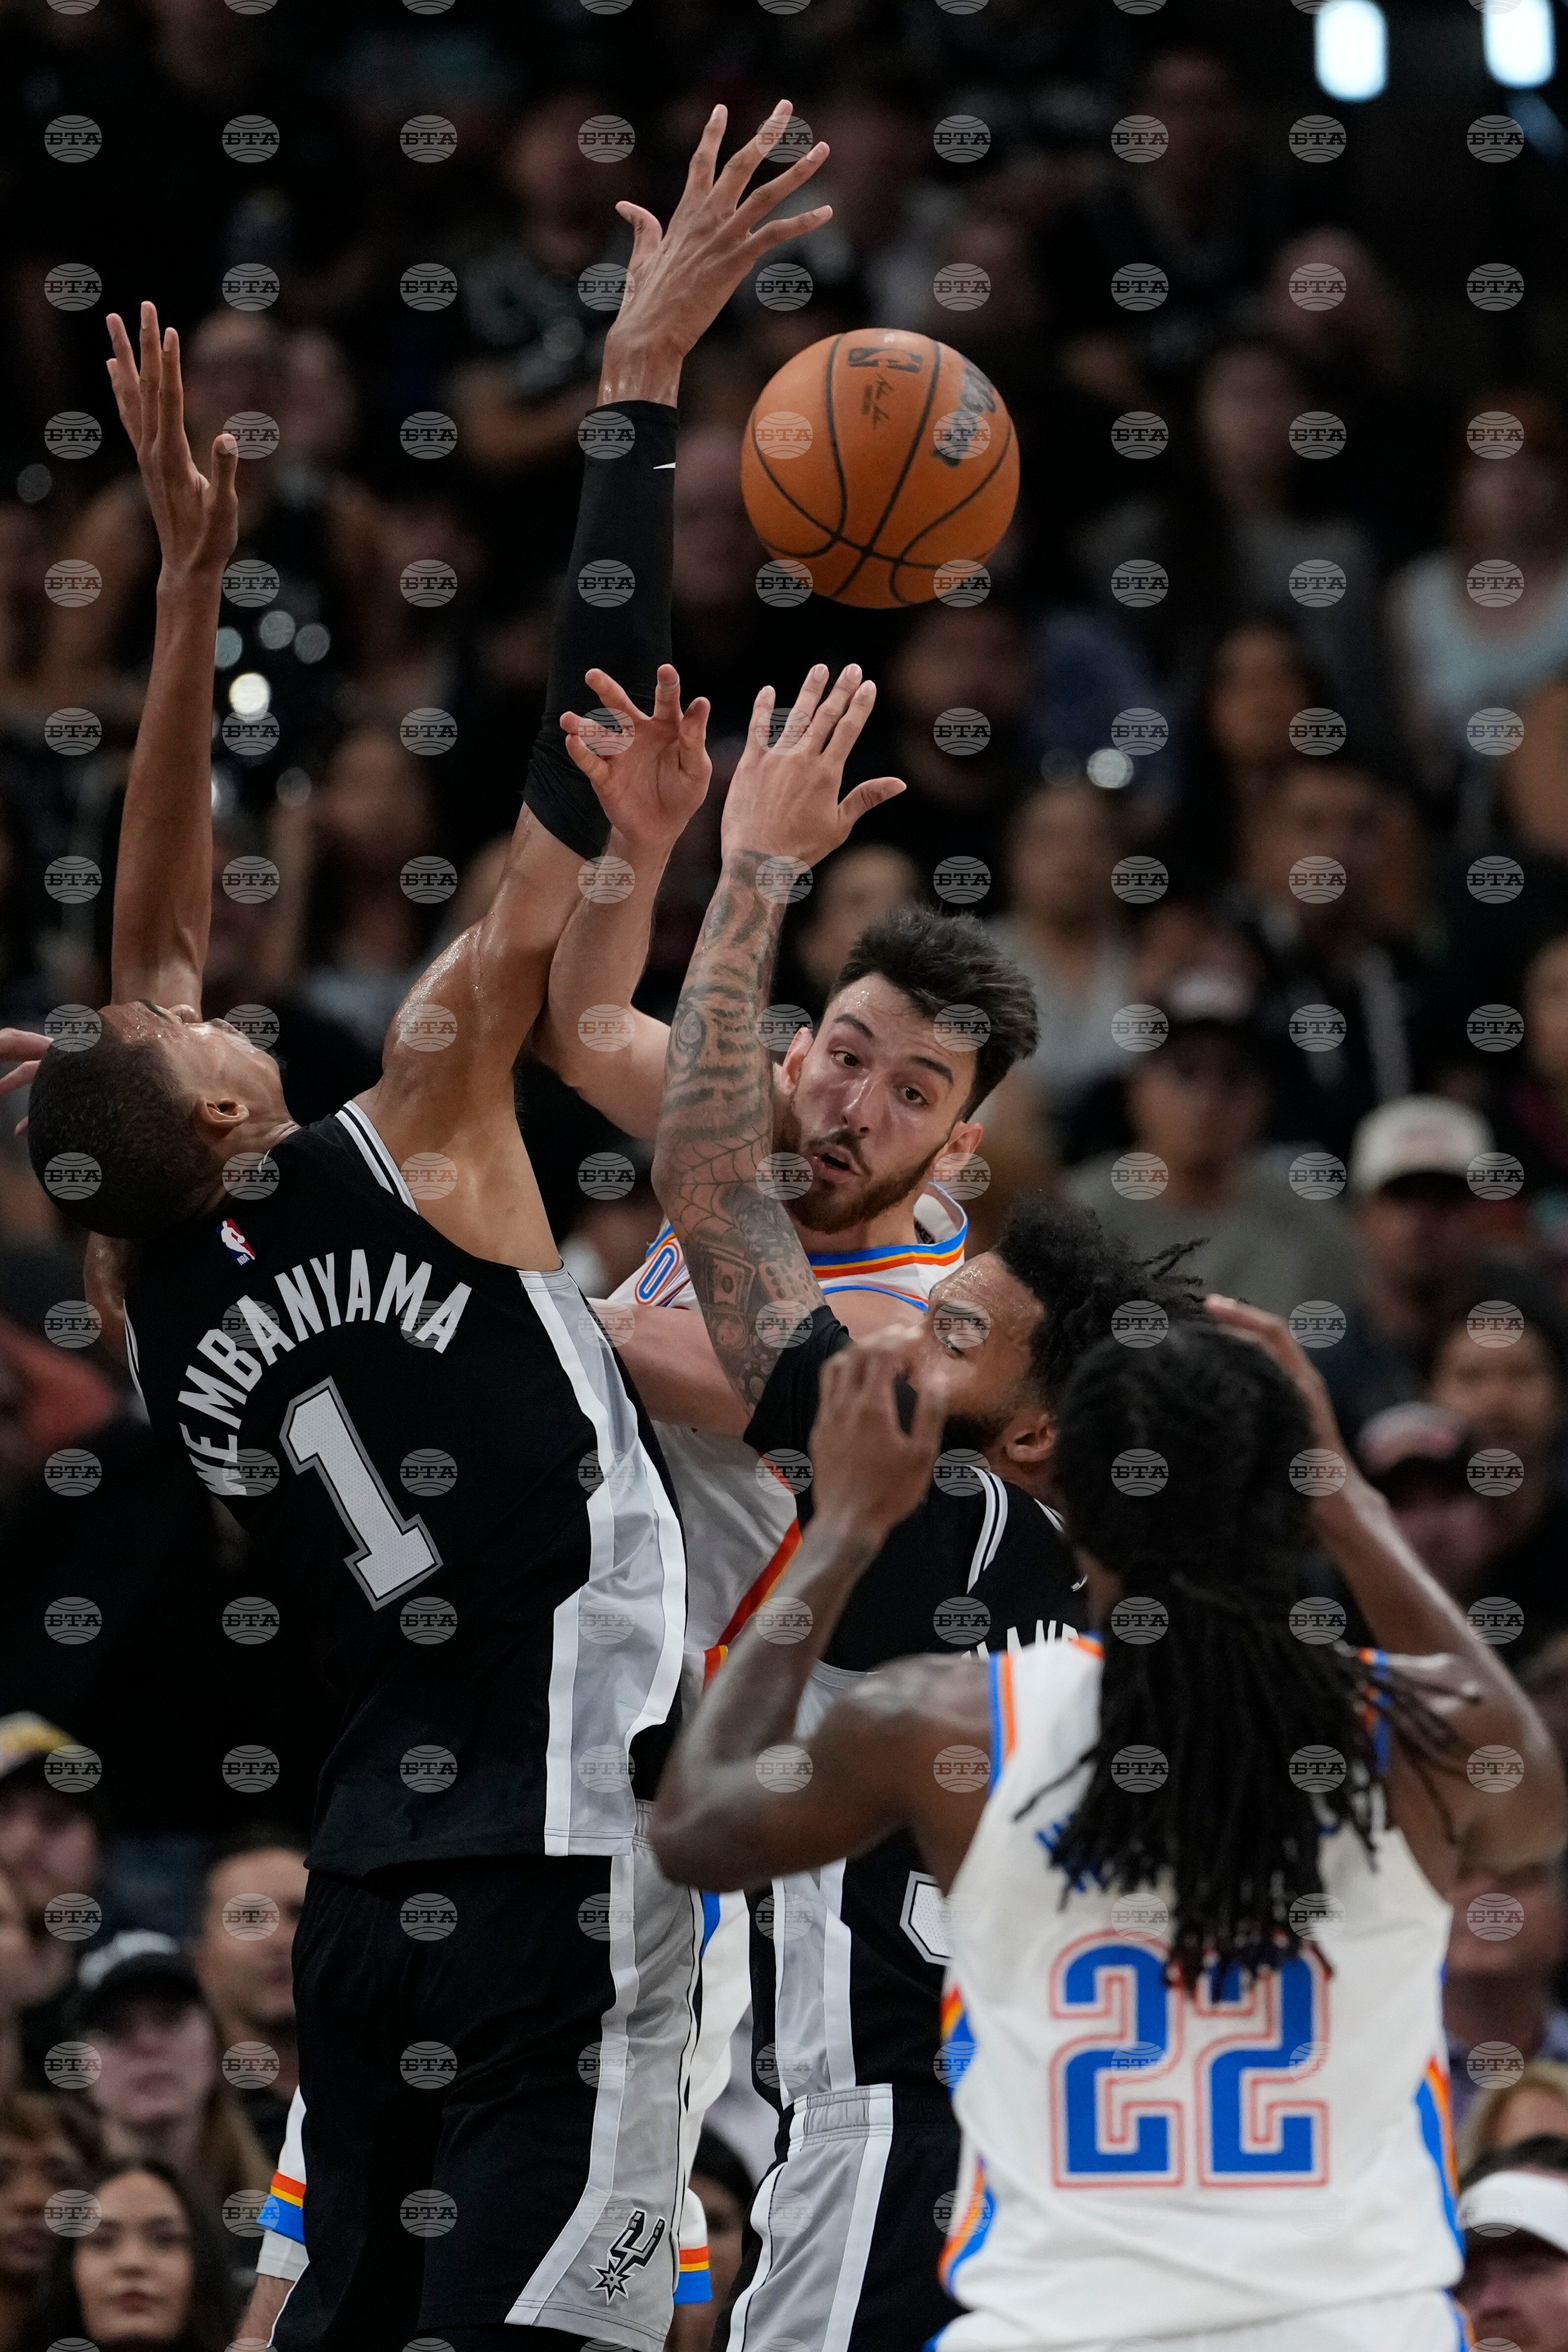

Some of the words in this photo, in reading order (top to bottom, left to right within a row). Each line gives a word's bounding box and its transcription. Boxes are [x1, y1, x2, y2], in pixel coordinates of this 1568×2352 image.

[178, 1249, 472, 1496] WEMBANYAMA
[279, 1376, 443, 1612] 1
[1049, 1929, 1330, 2189] 22
